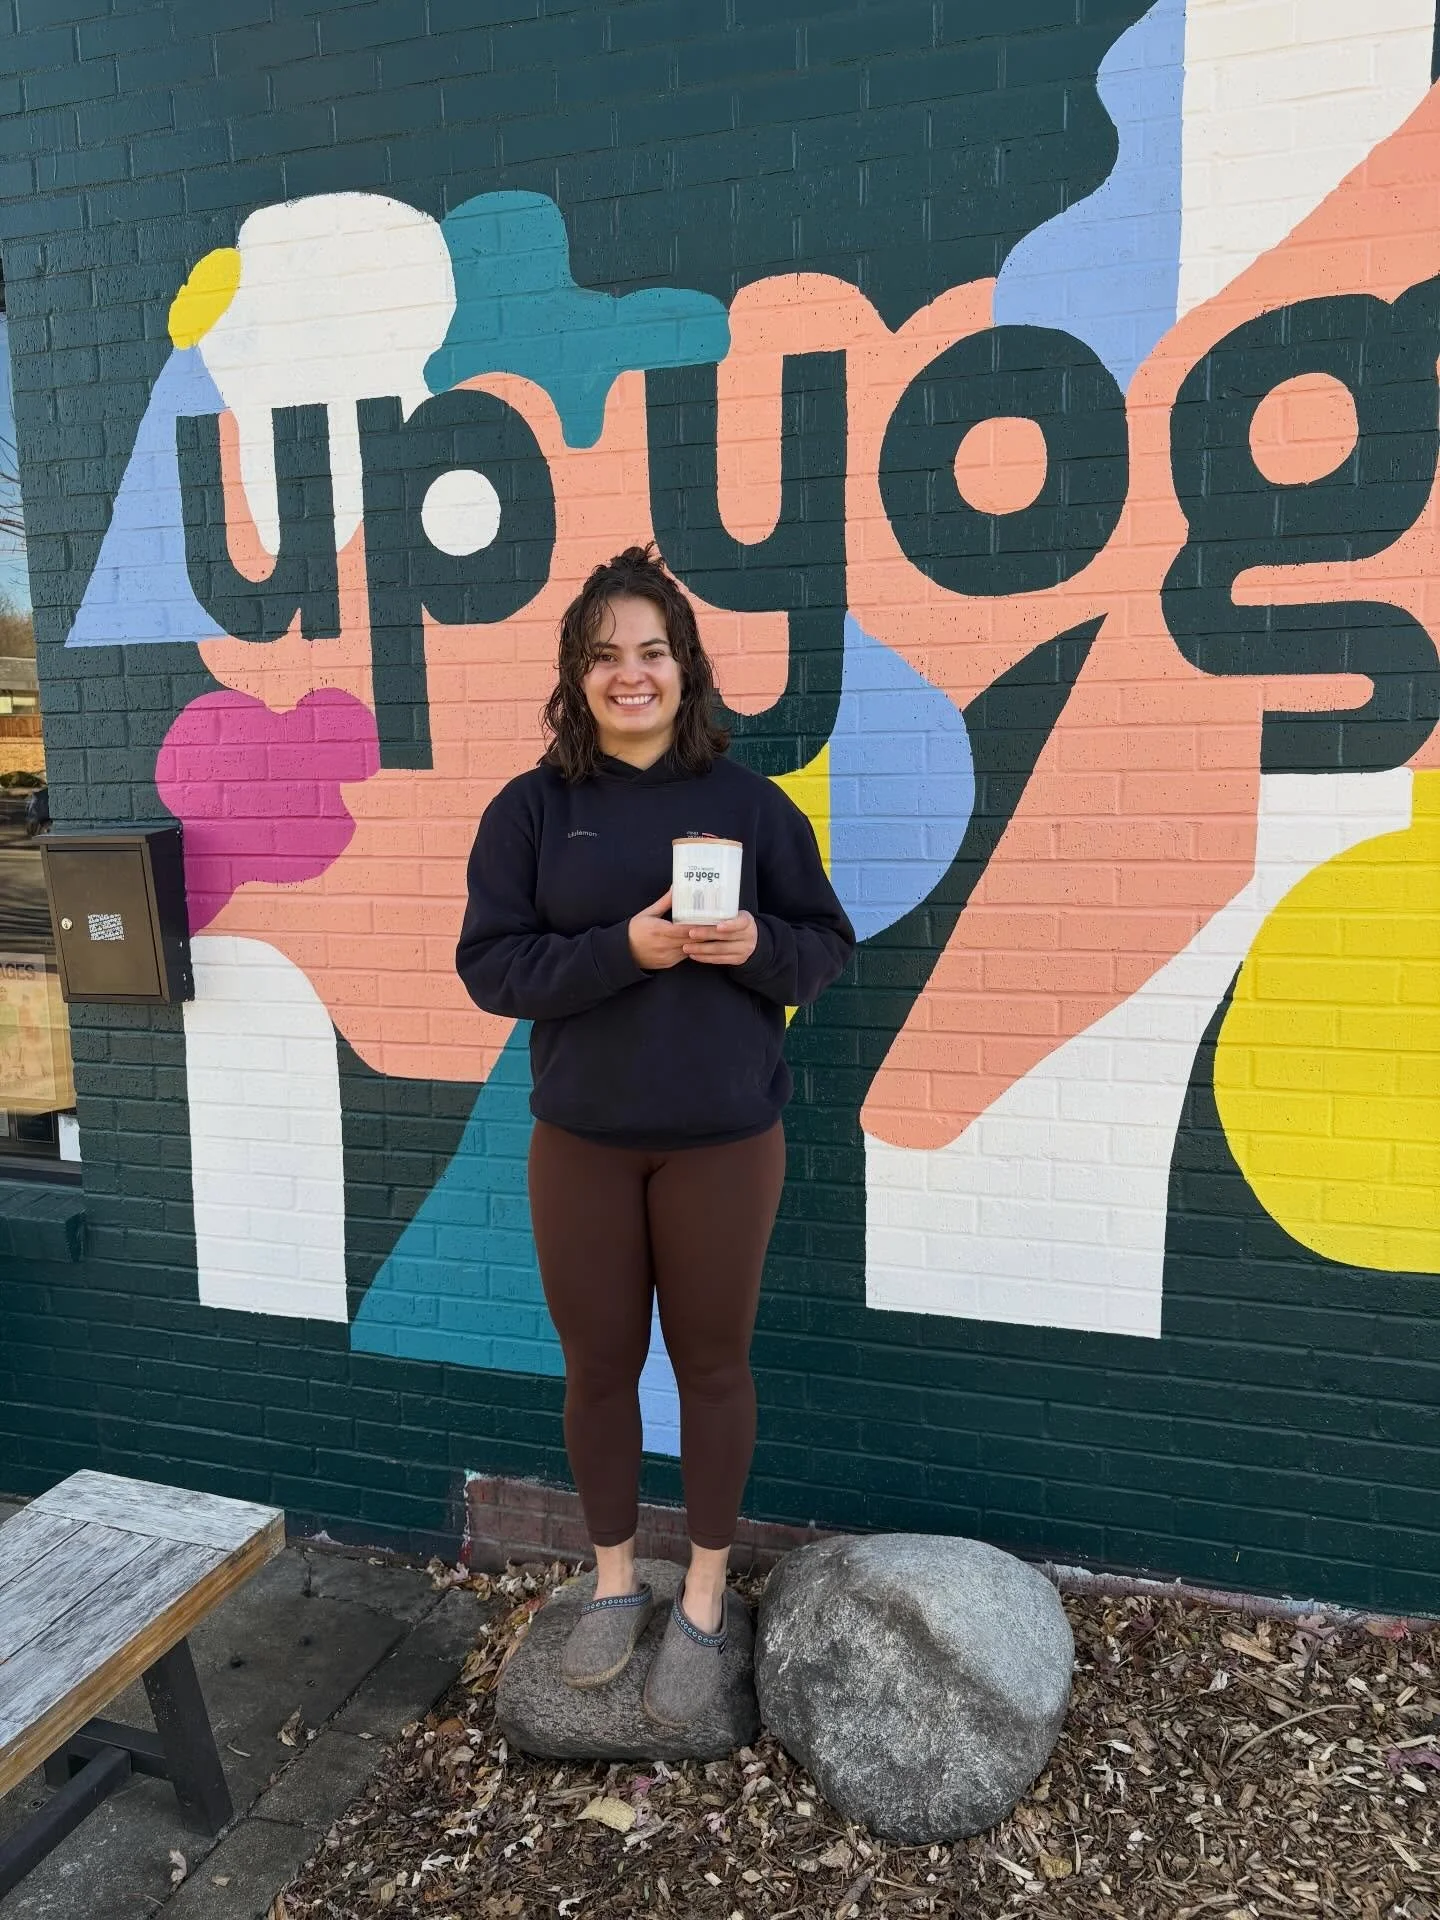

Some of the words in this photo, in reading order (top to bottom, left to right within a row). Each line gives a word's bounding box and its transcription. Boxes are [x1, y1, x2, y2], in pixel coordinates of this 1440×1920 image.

[175, 388, 557, 770] up
[684, 871, 694, 881] up
[695, 871, 720, 883] yoga
